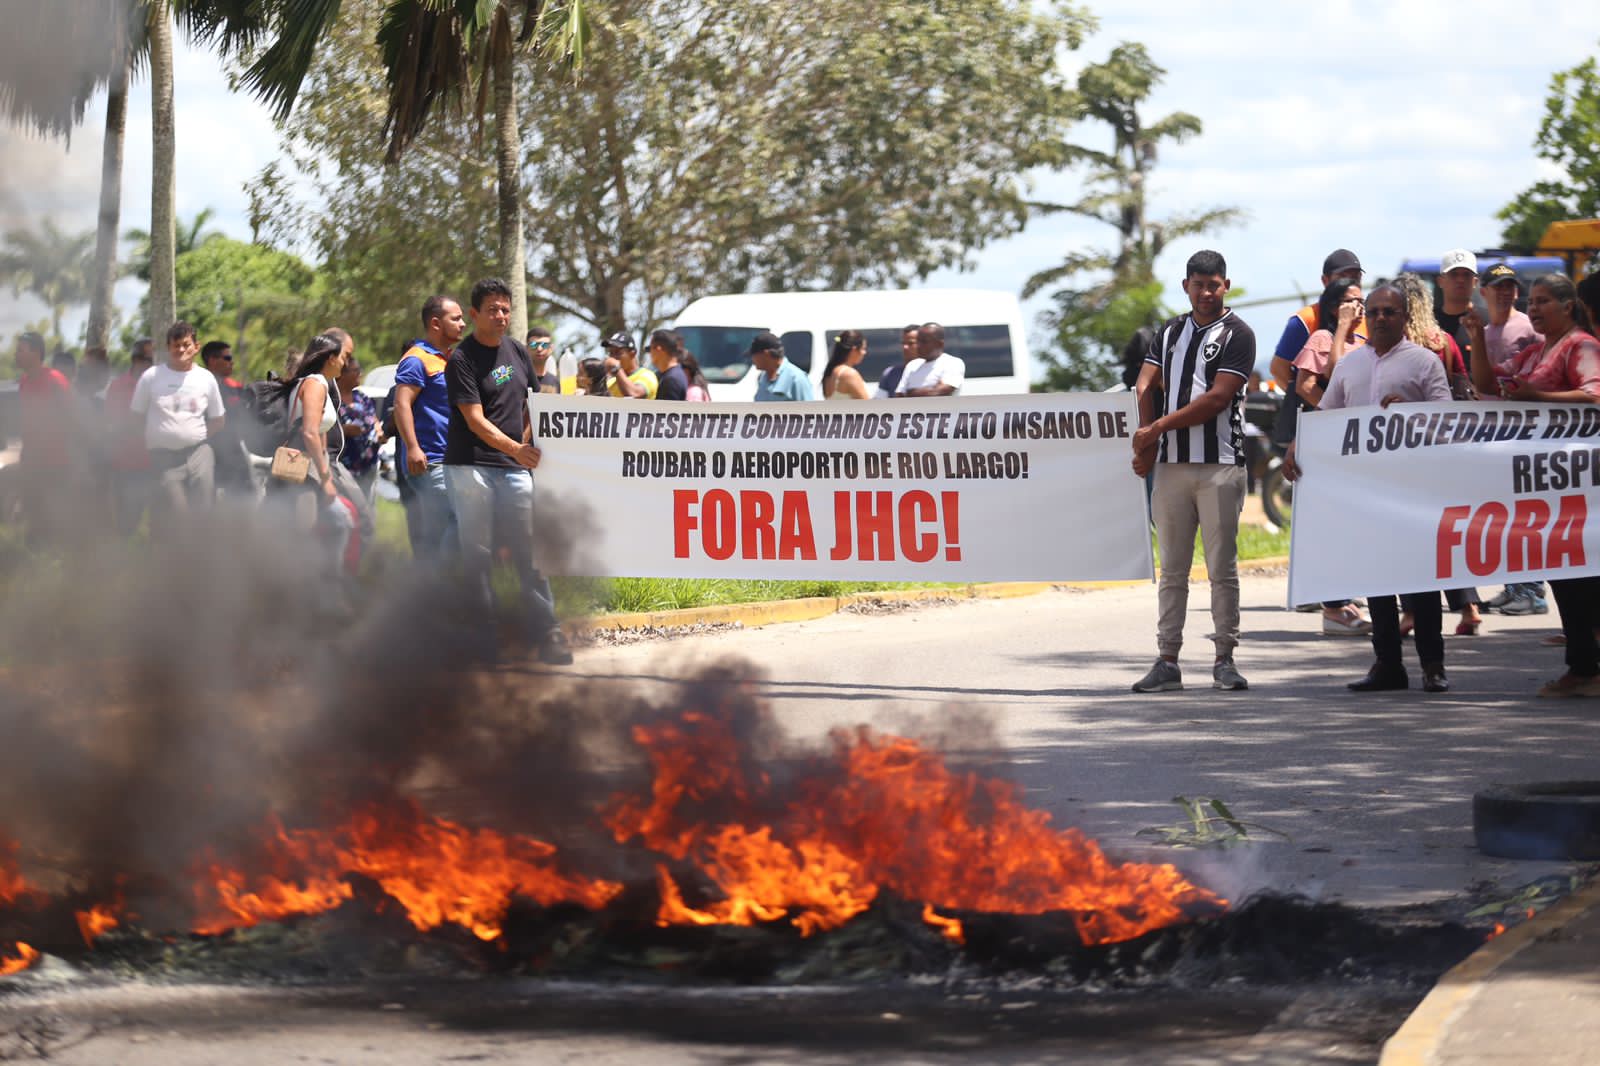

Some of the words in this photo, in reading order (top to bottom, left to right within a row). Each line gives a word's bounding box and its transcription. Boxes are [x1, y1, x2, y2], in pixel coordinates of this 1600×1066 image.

[538, 411, 620, 439] ASTARIL
[625, 412, 738, 439] PRESENTE!
[741, 413, 894, 440] CONDENAMOS
[896, 412, 949, 440] ESTE
[953, 411, 997, 440] ATO
[1003, 411, 1092, 440] INSANO
[1098, 411, 1129, 438] DE
[1341, 418, 1360, 456] A
[1366, 409, 1540, 453] SOCIEDADE
[622, 451, 707, 478] ROUBAR
[712, 451, 726, 478] O
[731, 451, 858, 479] AEROPORTO
[864, 452, 893, 479] DE
[898, 452, 938, 480] RIO
[943, 451, 1029, 480] LARGO!
[673, 488, 818, 561] FORA
[830, 489, 962, 563] JHC!
[1435, 494, 1588, 580] FORA
